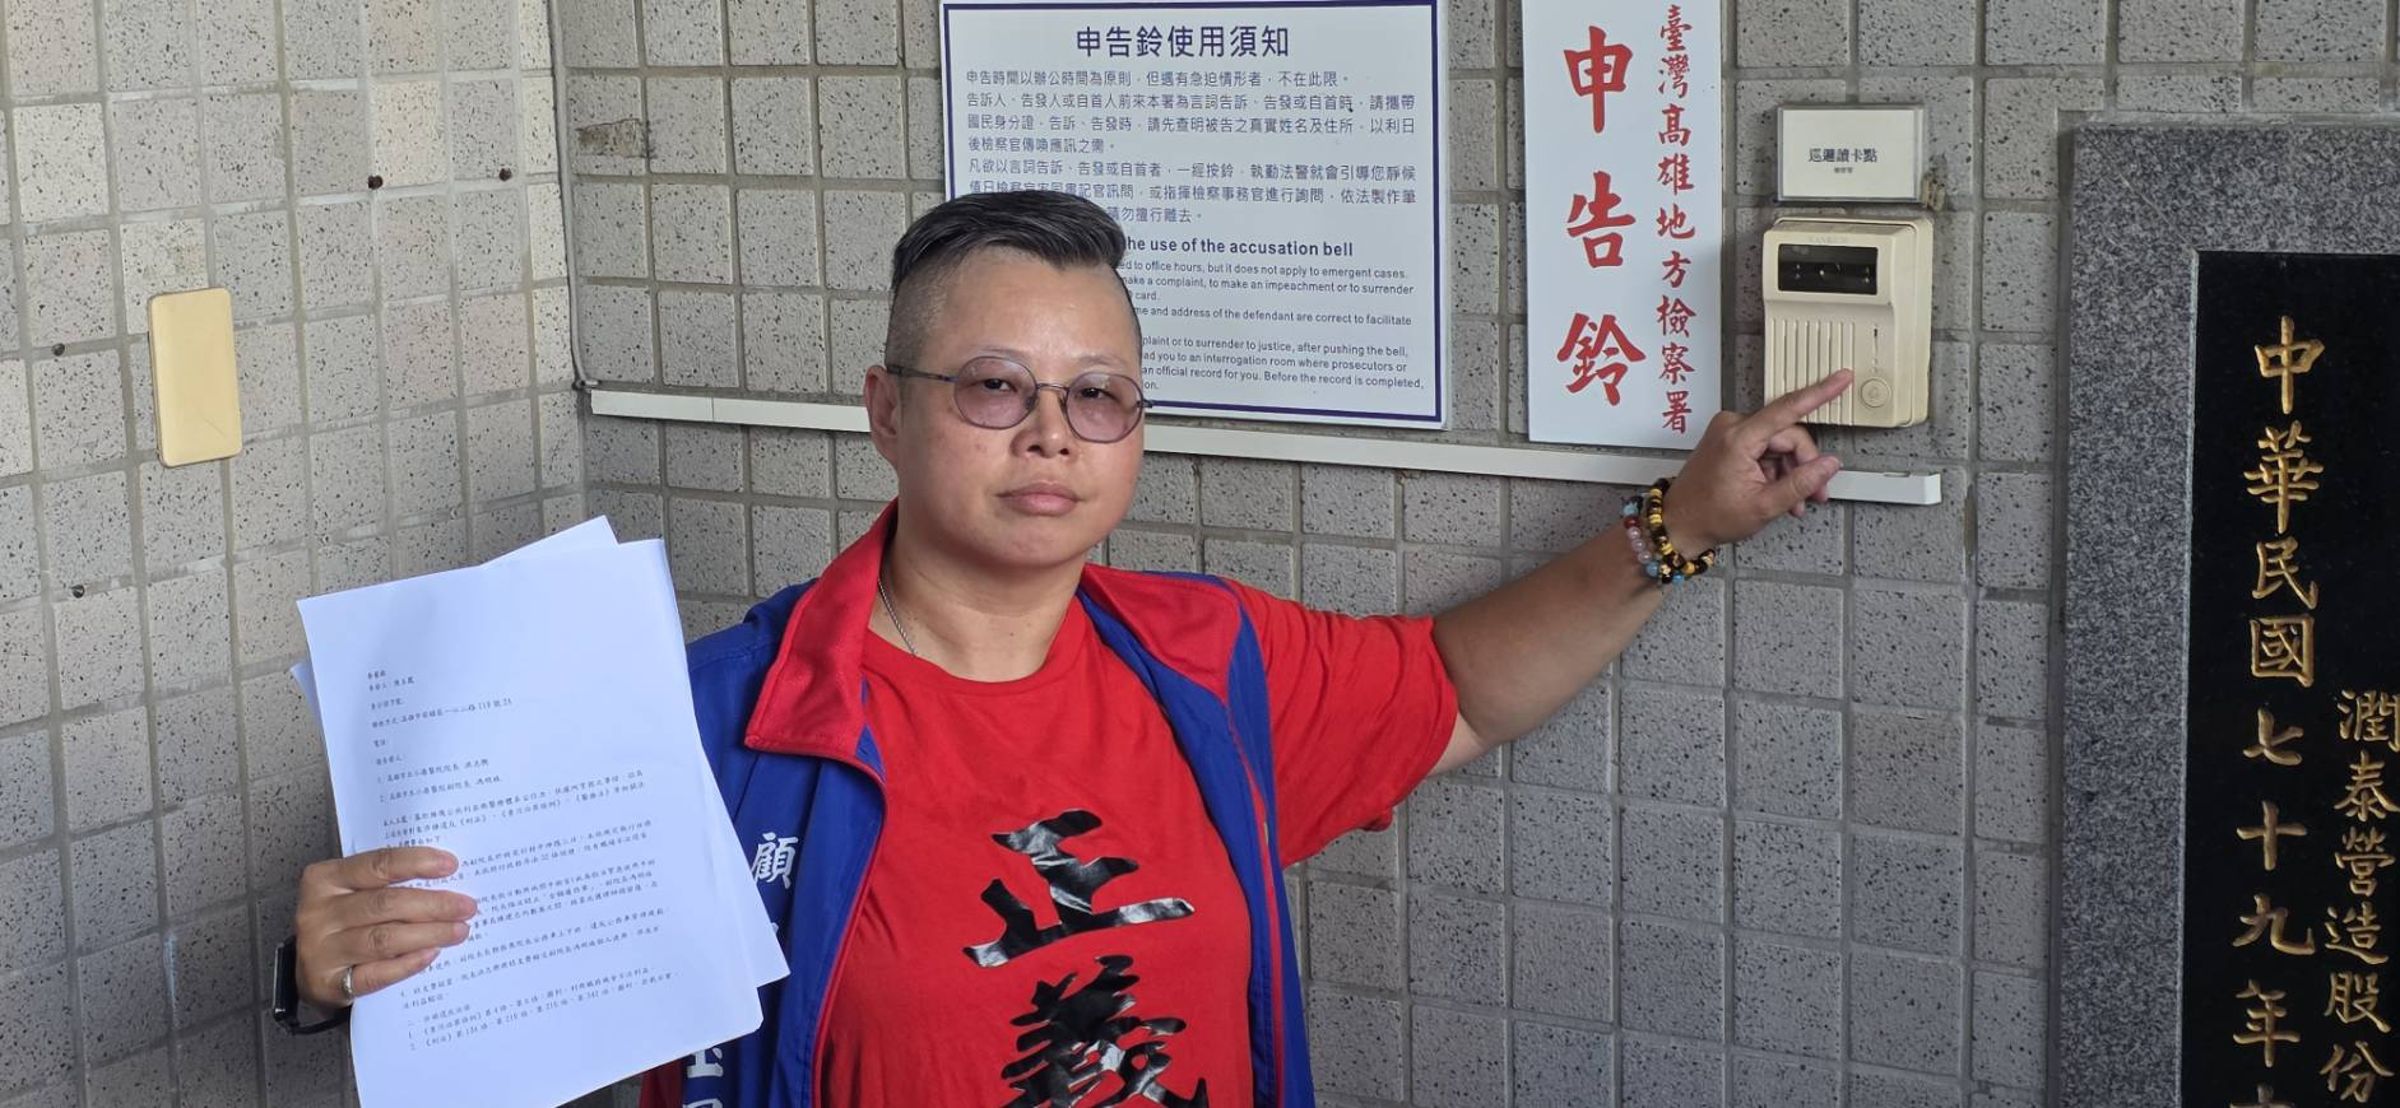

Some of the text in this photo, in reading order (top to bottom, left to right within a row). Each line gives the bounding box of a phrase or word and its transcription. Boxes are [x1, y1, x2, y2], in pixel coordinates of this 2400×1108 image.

[1077, 25, 1290, 57] 申告鈴使用須知
[1557, 26, 1646, 406] 申告鈴
[1657, 5, 1695, 434] 臺灣高雄地方檢察署
[1128, 237, 1353, 256] he use of the accusation bell
[2229, 316, 2324, 1108] 中華民國七十九年
[2318, 689, 2400, 1103] 潤泰營造股份
[962, 807, 1209, 1108] 正義
